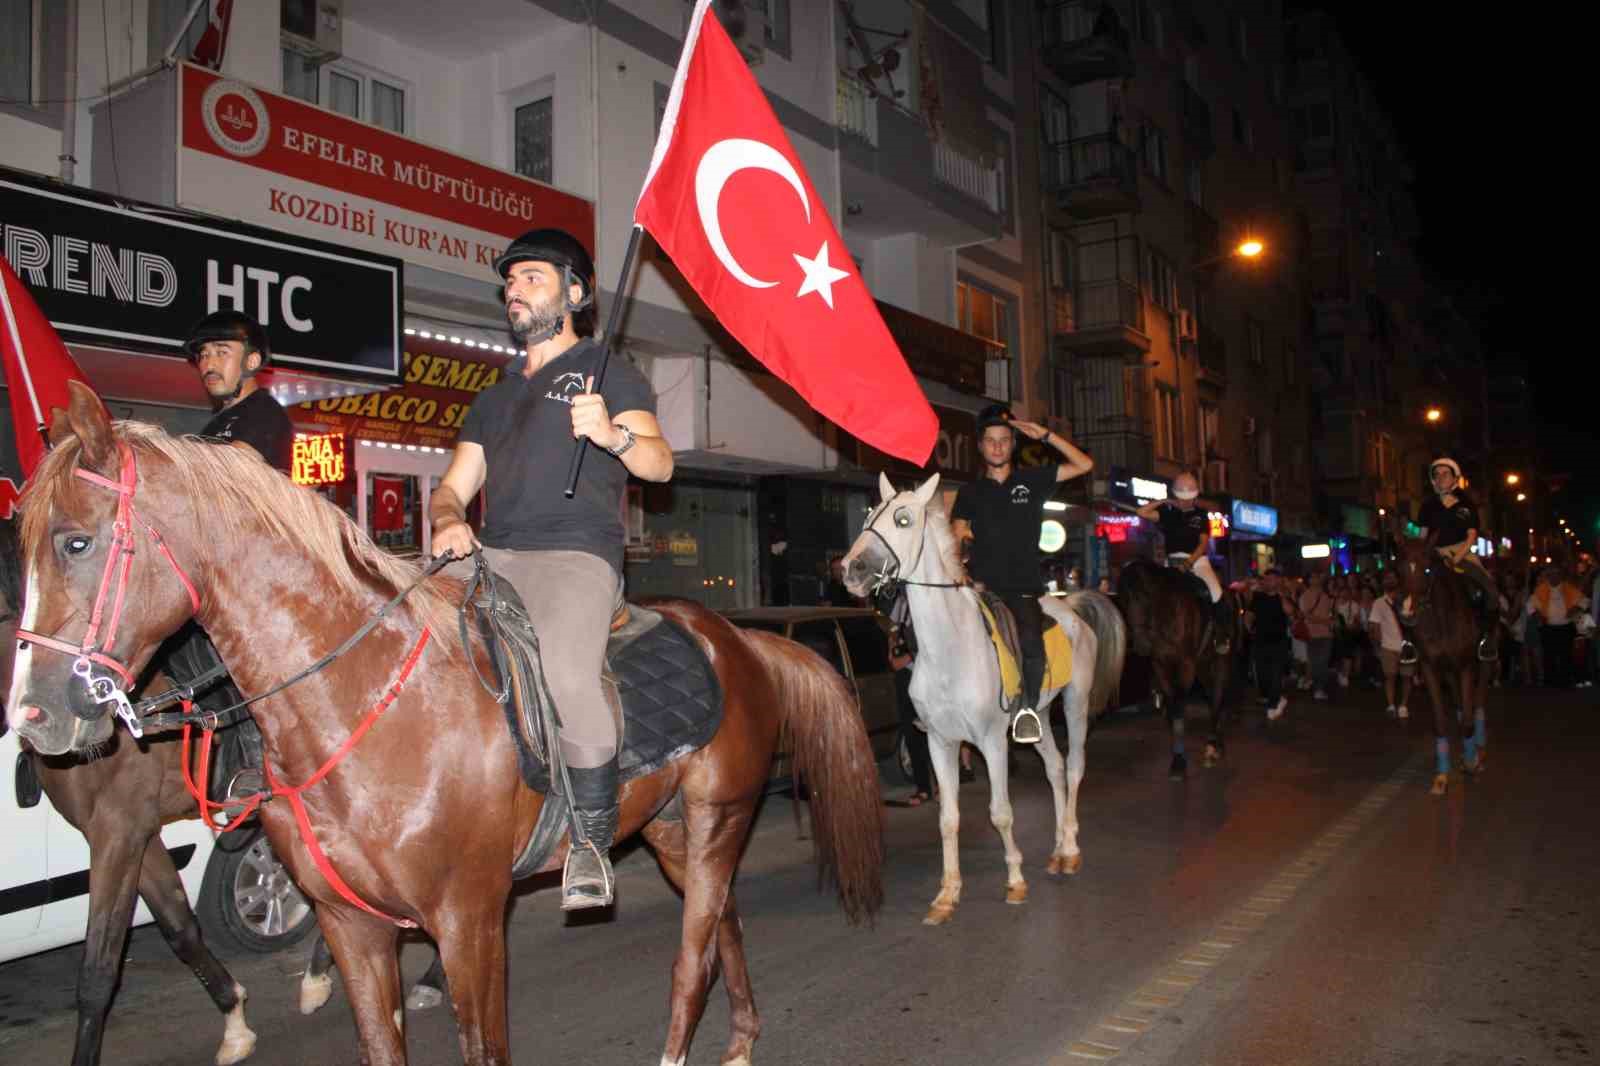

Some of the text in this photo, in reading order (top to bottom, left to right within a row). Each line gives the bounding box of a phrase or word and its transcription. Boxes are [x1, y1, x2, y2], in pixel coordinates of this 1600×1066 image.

[282, 126, 535, 221] EFELER MÜFTÜLÜĞÜ
[268, 188, 376, 237] KOZDİBİ
[0, 222, 314, 333] REND HTC
[301, 393, 438, 424] OBACCO
